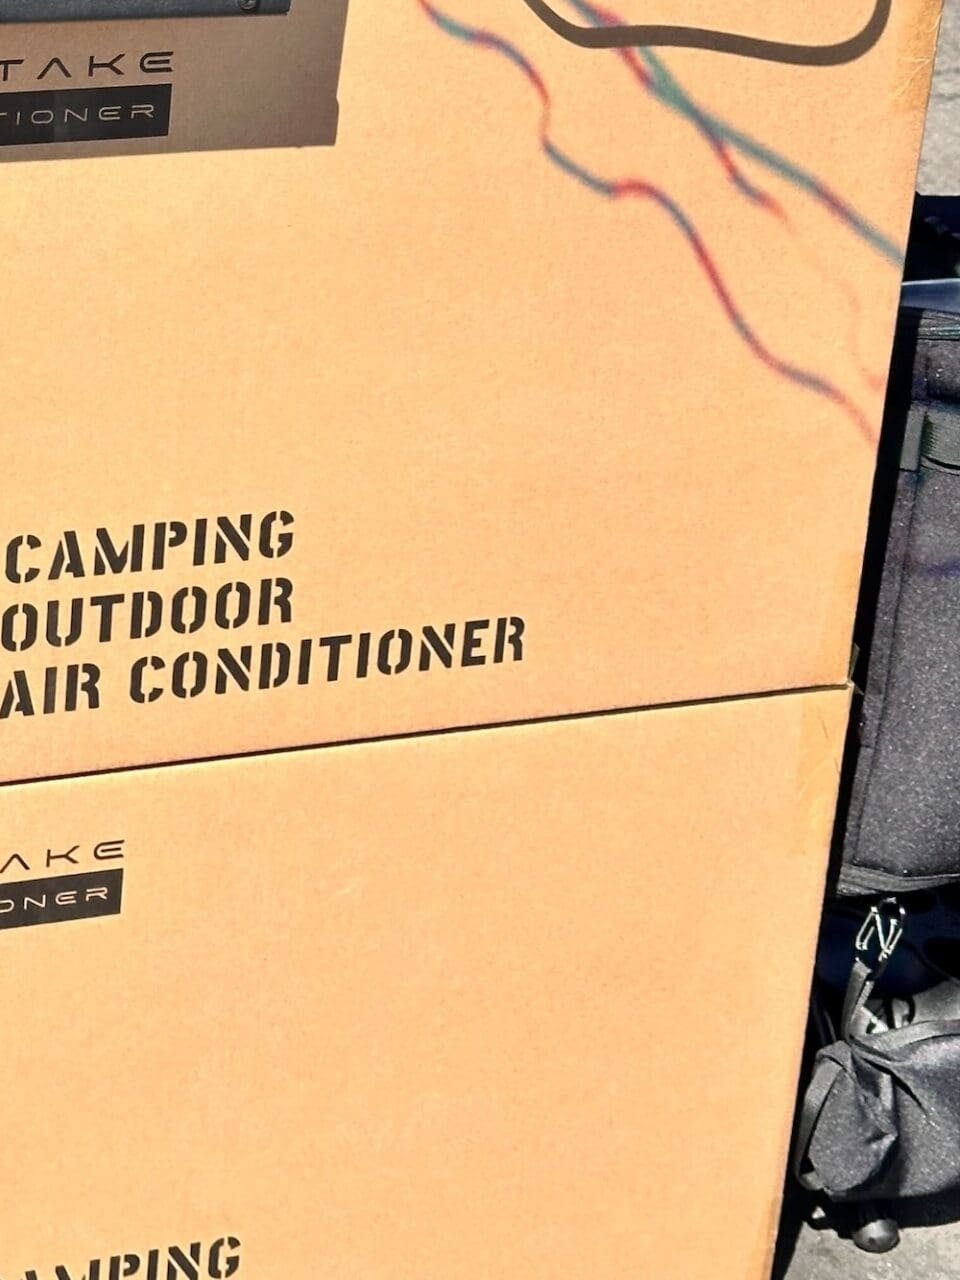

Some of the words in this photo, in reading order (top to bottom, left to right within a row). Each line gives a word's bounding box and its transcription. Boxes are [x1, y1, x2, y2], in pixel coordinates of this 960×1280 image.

[6, 511, 296, 584] CAMPING
[2, 578, 293, 651] OUTDOOR
[130, 616, 524, 704] CONDITIONER
